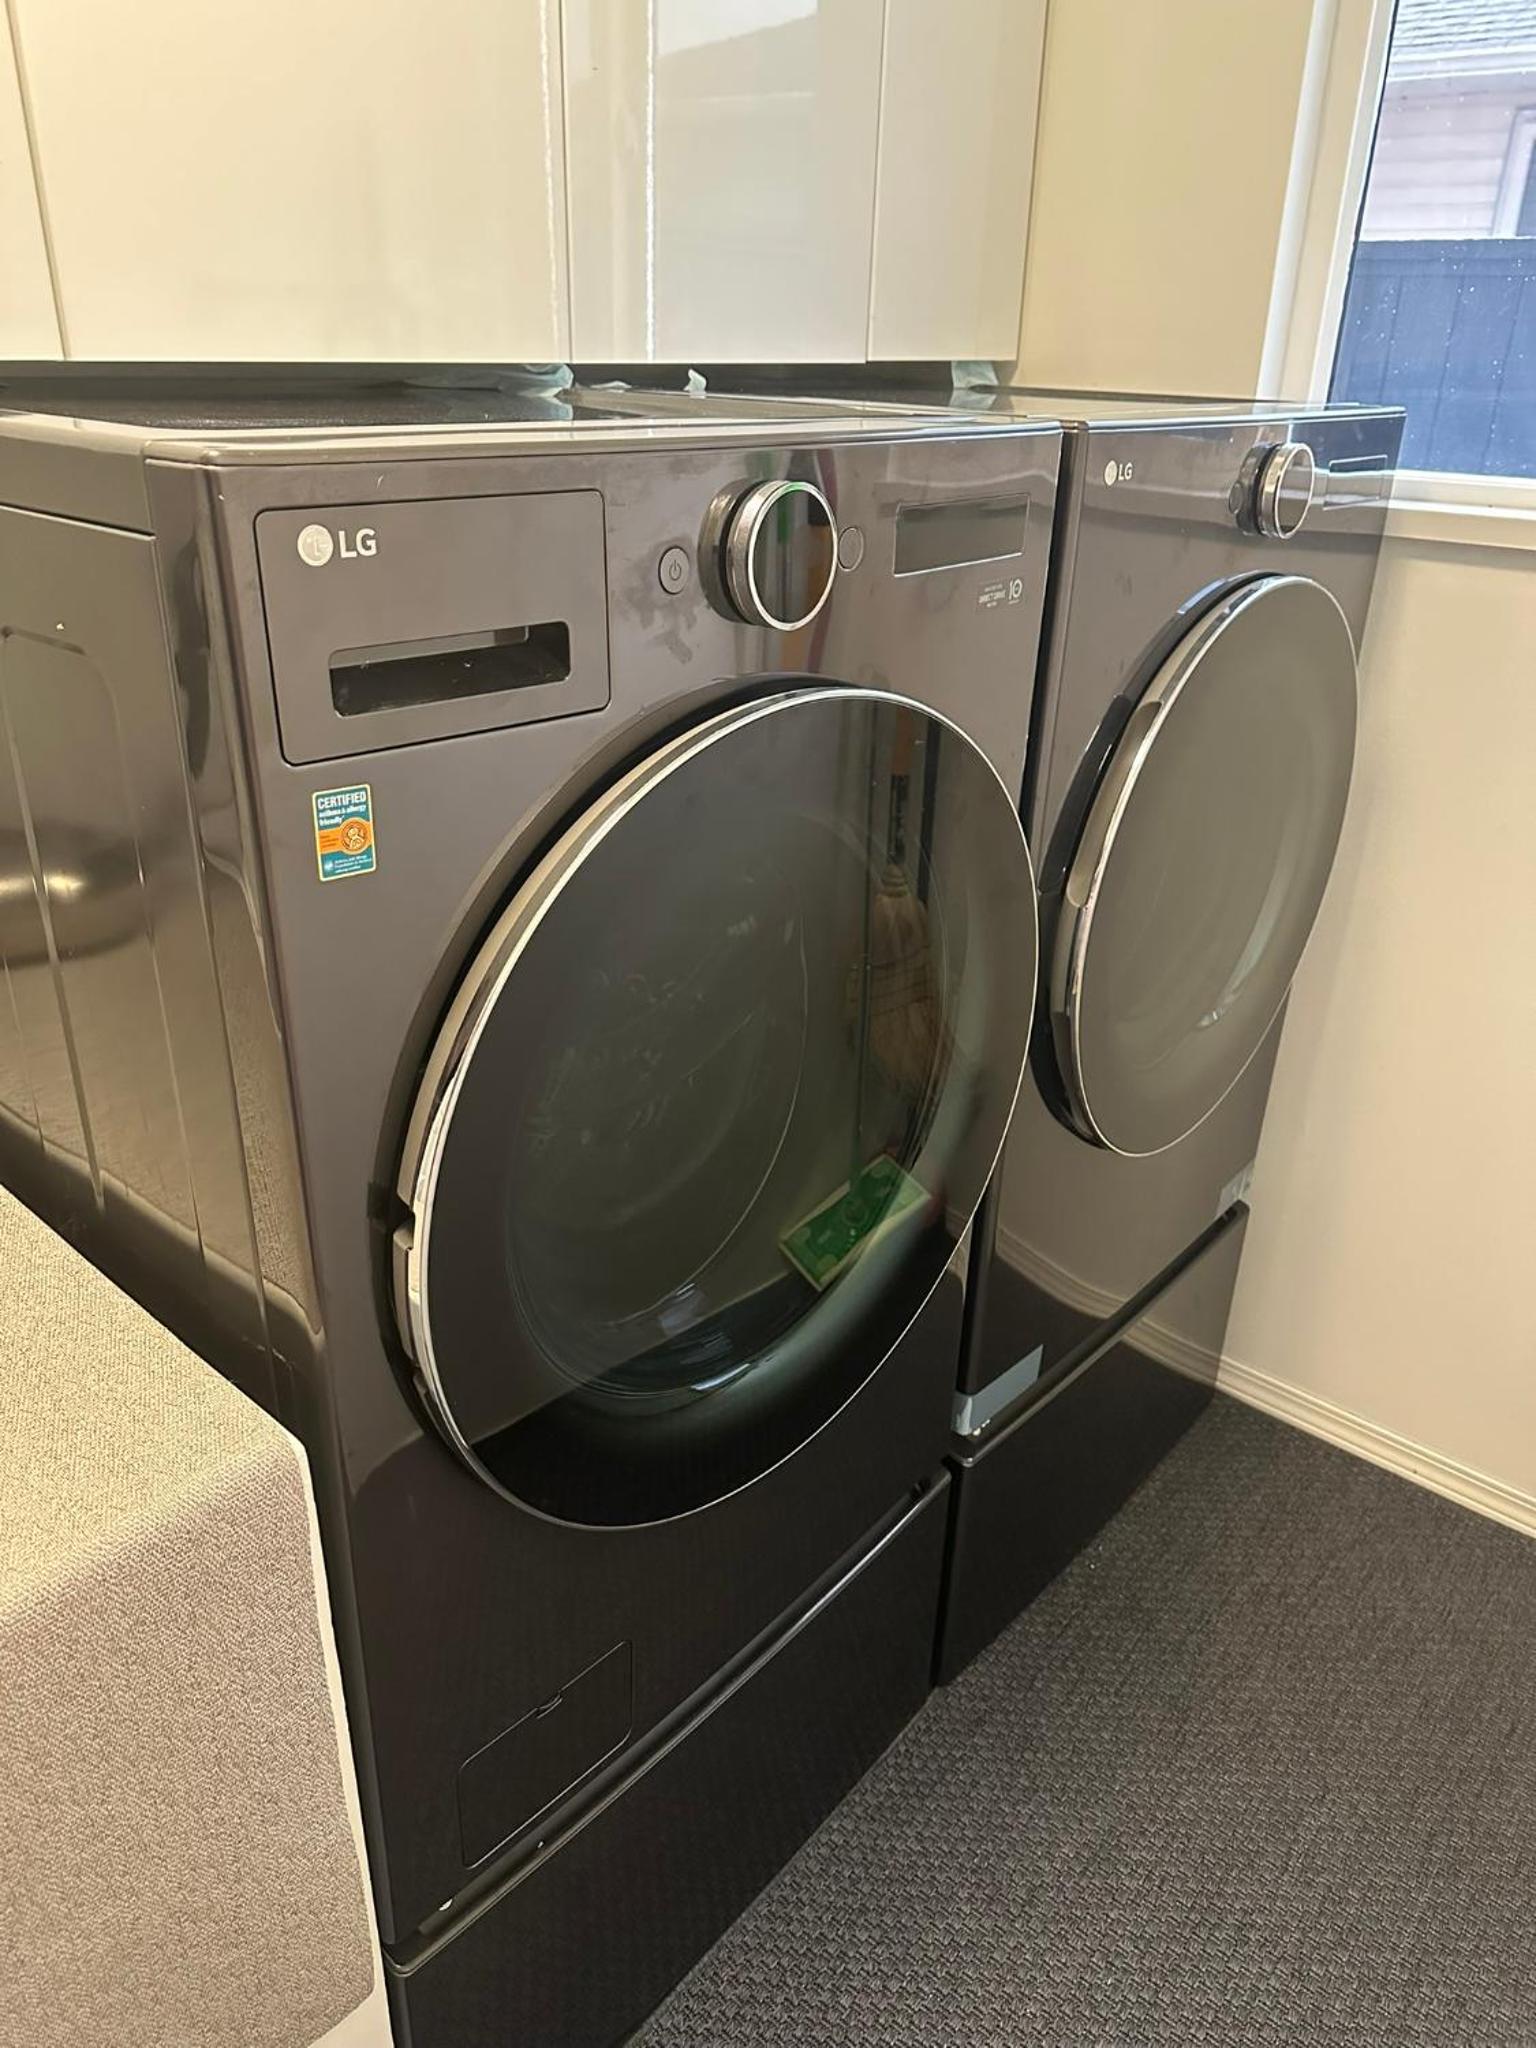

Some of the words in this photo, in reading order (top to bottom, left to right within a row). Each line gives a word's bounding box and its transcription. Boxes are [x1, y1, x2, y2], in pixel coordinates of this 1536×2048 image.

[1118, 462, 1133, 481] LG
[338, 527, 377, 558] LG
[317, 791, 367, 809] CERTIFIED
